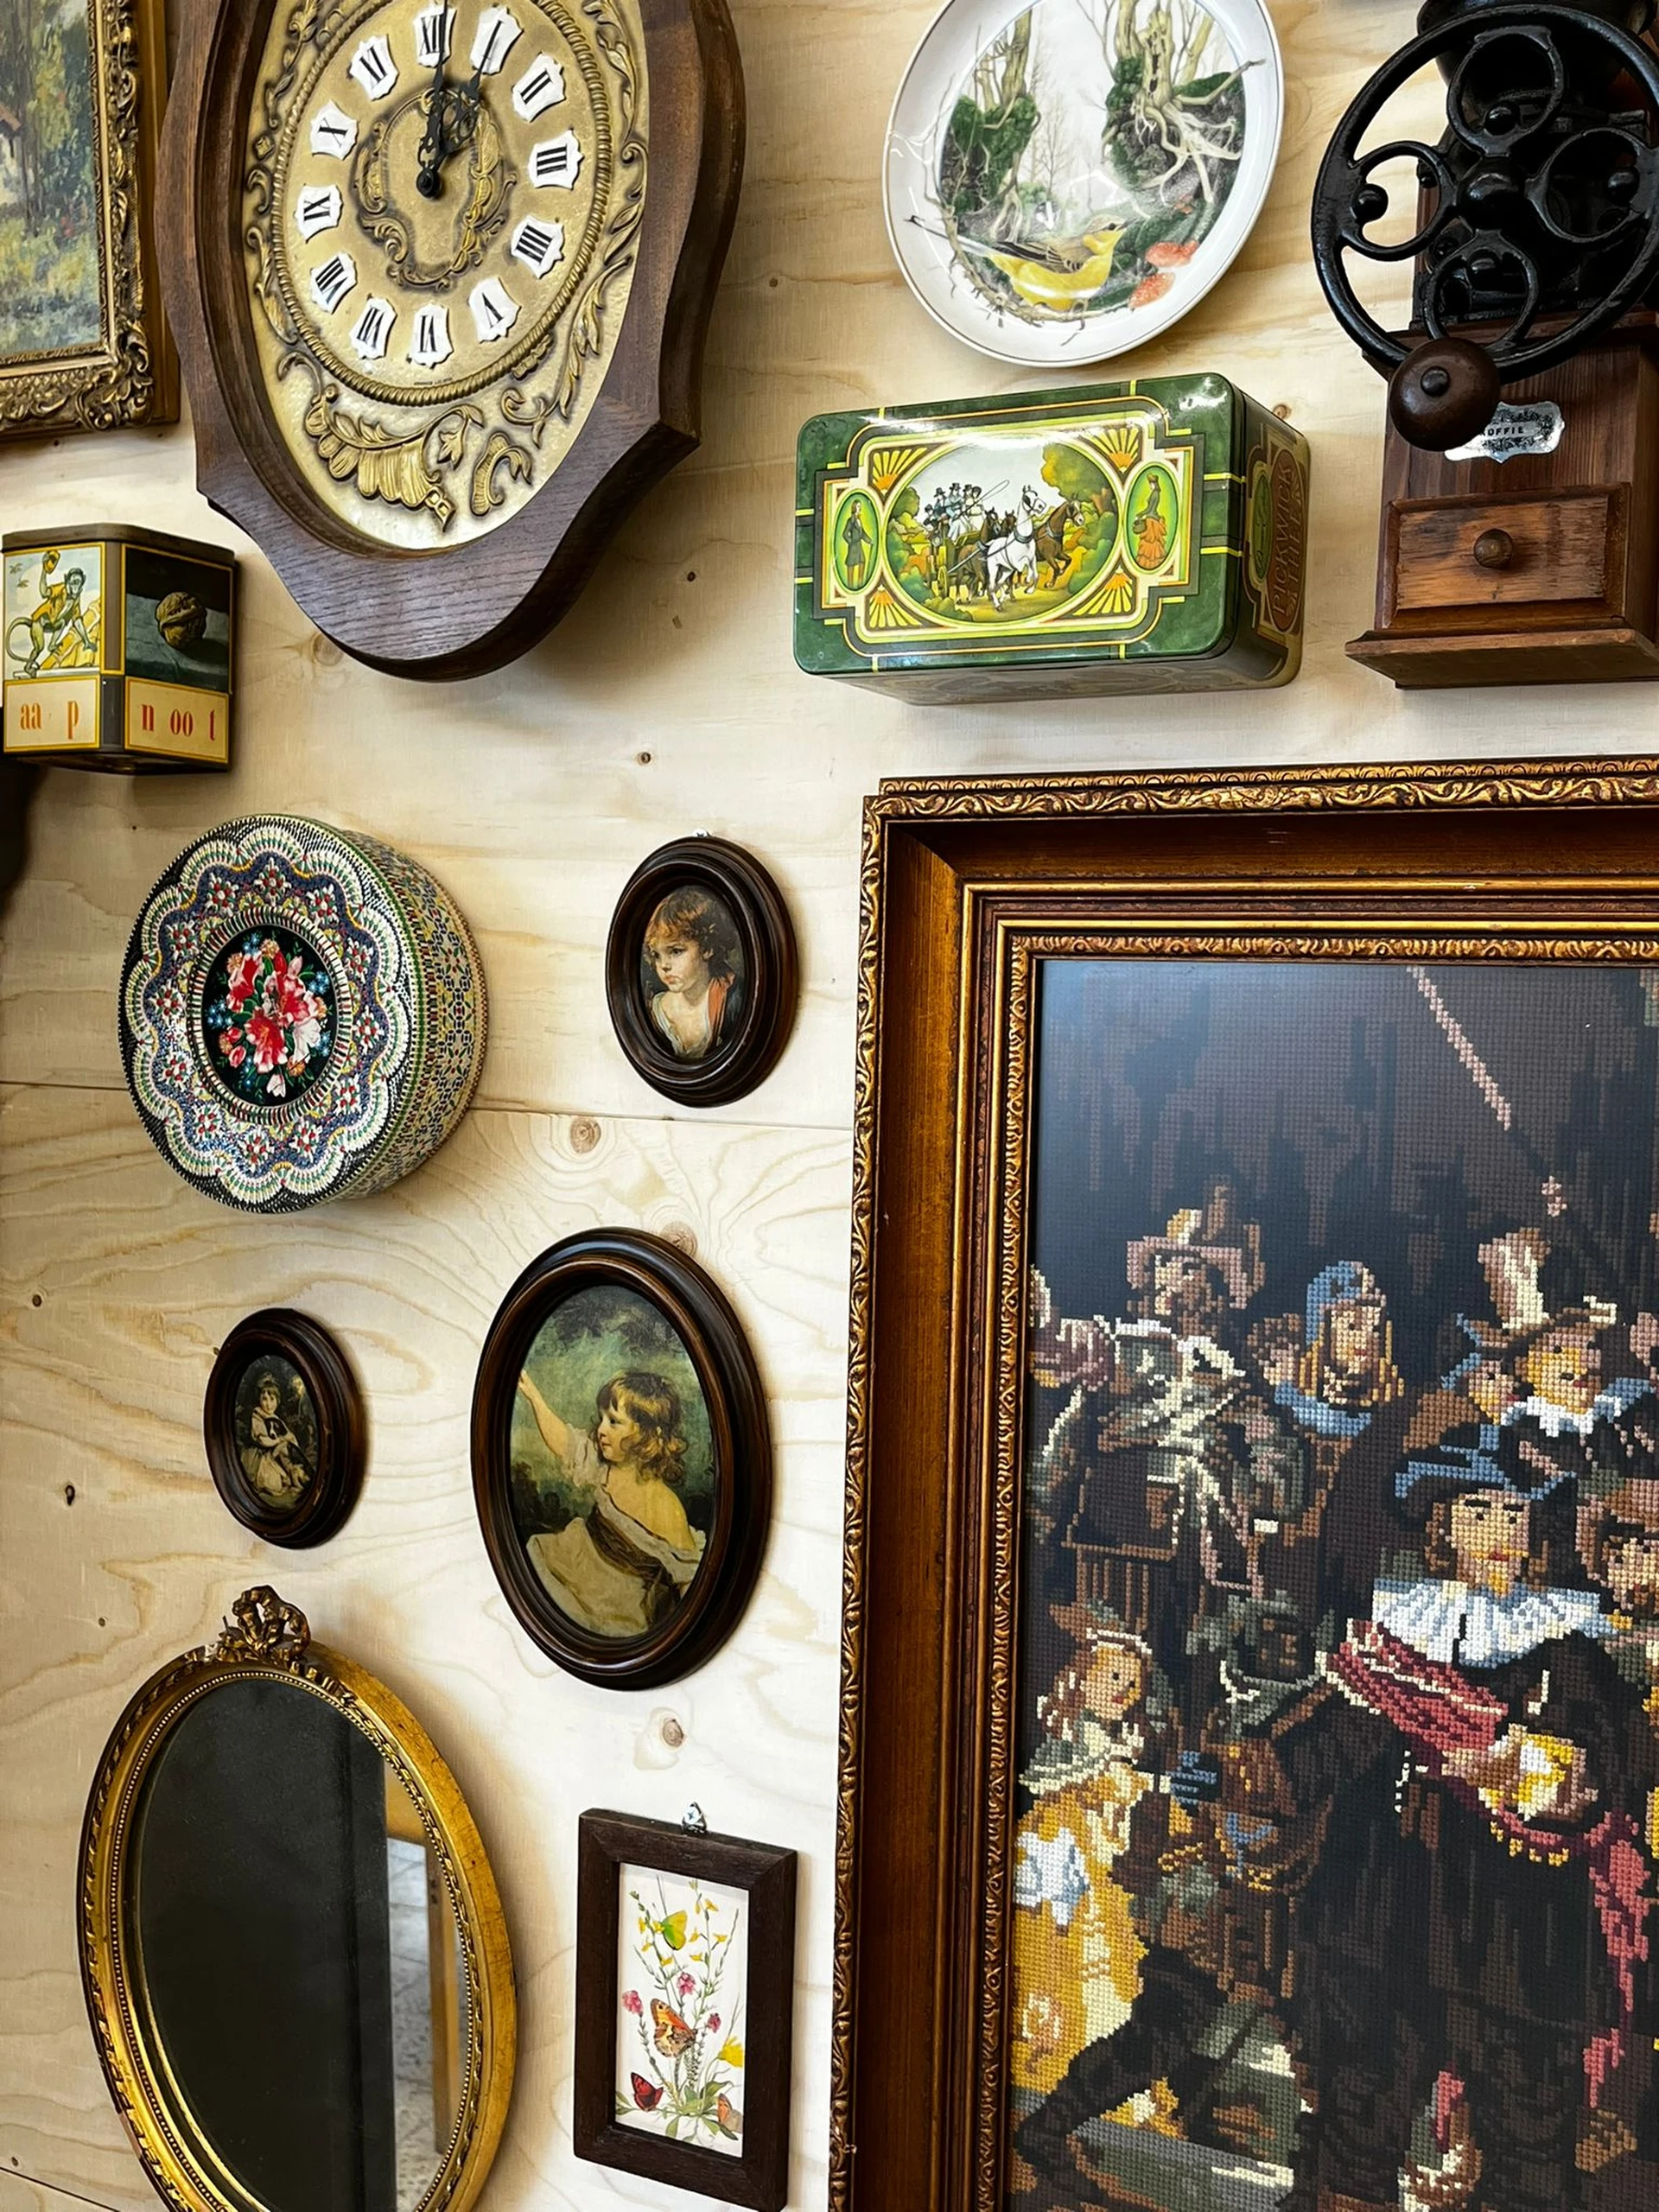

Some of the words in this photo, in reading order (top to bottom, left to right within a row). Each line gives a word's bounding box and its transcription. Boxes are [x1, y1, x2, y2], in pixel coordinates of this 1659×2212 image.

[359, 45, 388, 90] XI
[519, 67, 553, 105] II
[318, 118, 347, 148] X
[536, 143, 568, 177] III
[303, 192, 331, 221] IX
[315, 256, 348, 303] VIII
[356, 307, 385, 349] VII
[481, 292, 504, 328] V
[418, 315, 437, 353] VI
[1483, 426, 1525, 437] OFFIE
[1273, 461, 1292, 615] PICKWICK
